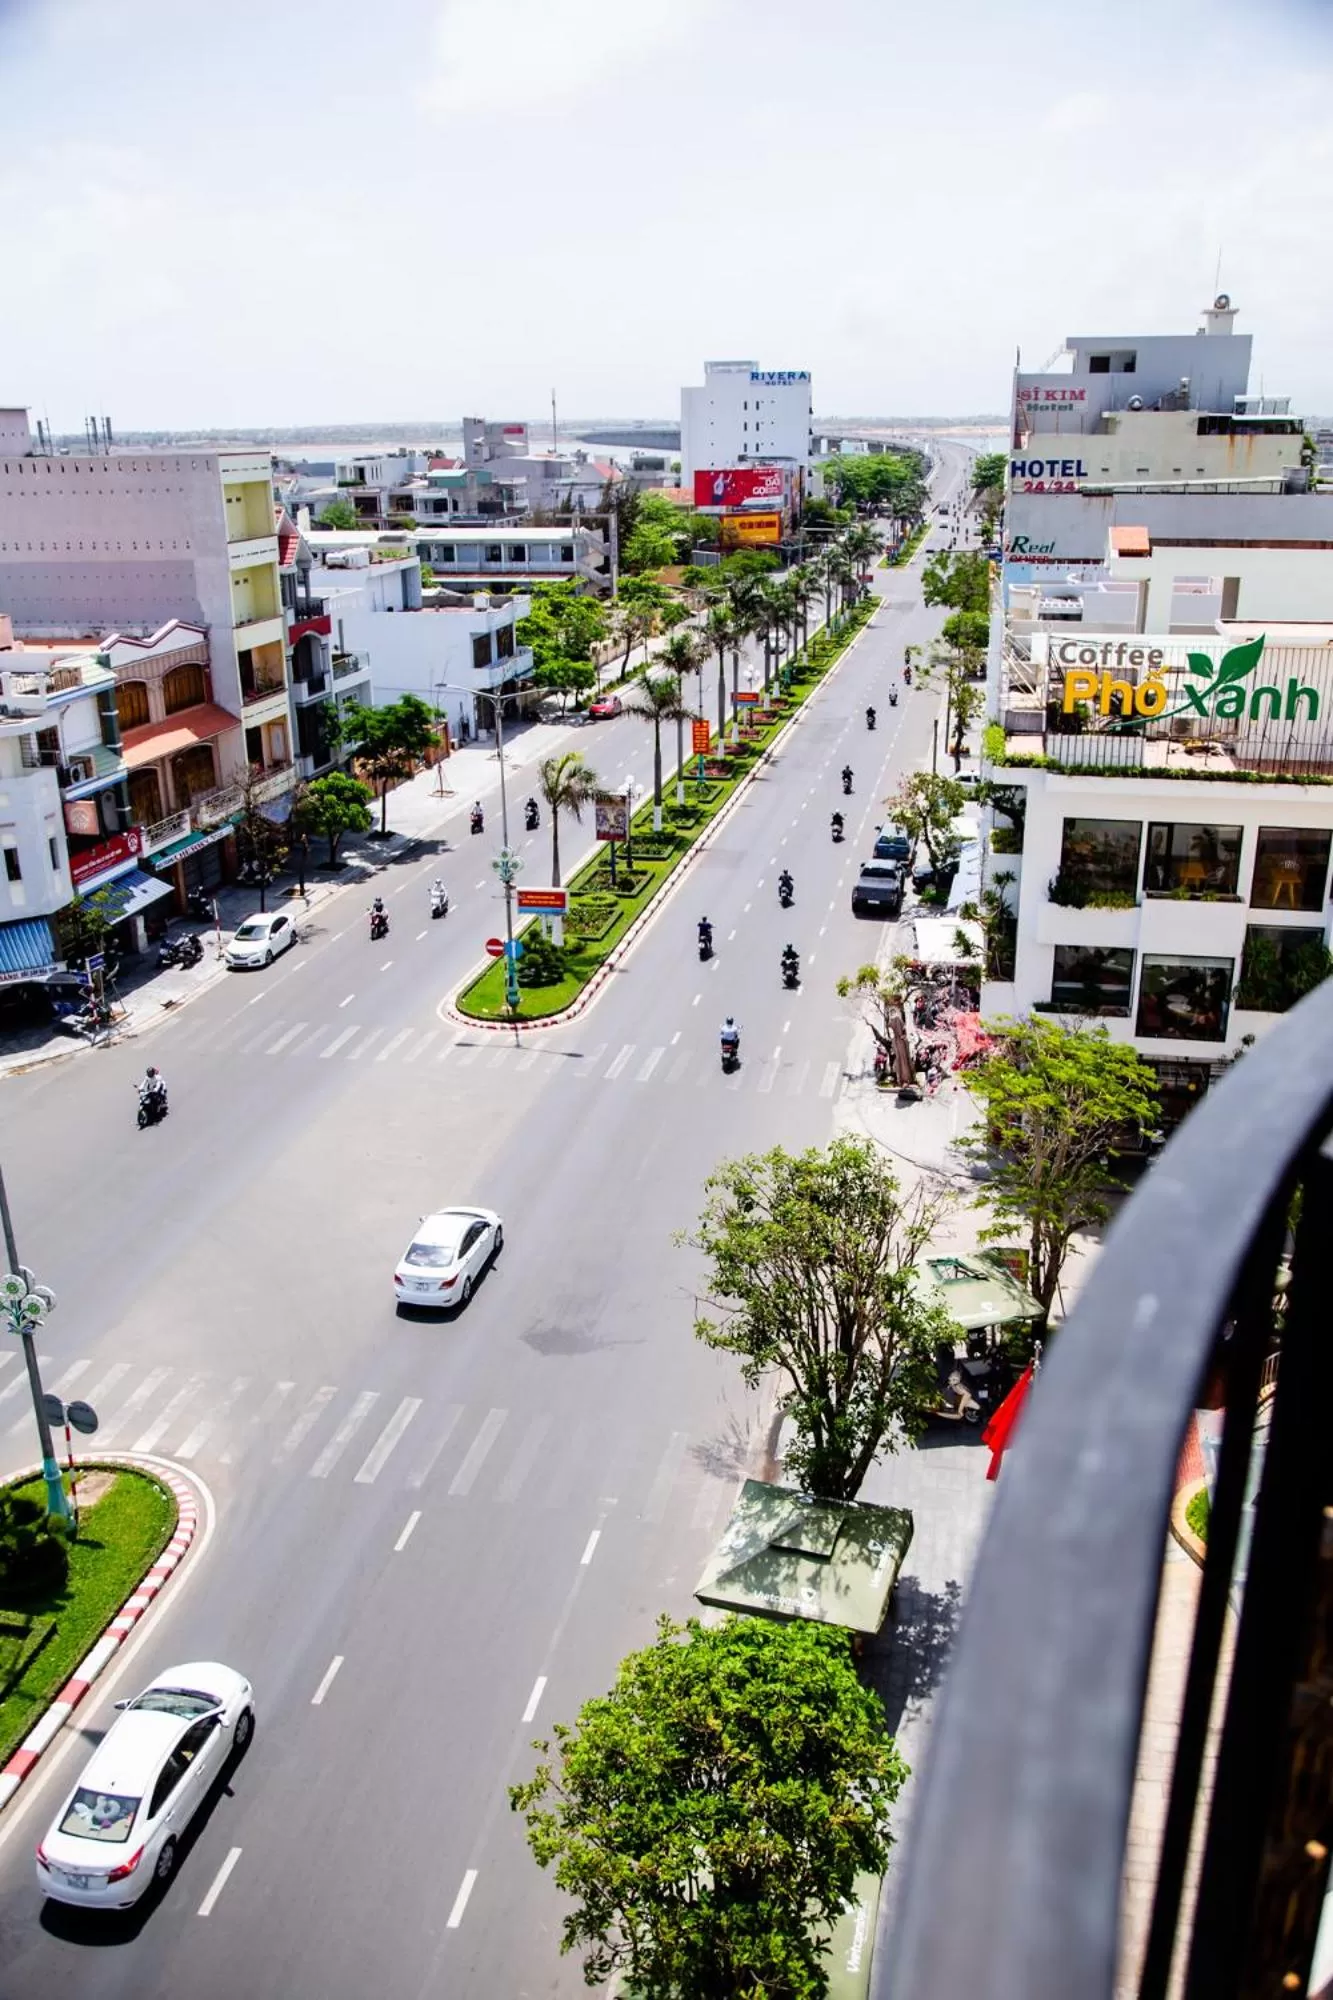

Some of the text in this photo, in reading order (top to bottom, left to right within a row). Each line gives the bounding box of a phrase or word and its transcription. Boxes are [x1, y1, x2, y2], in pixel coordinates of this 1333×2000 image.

[750, 371, 807, 381] RIVERA
[1044, 388, 1086, 401] KIM
[1026, 403, 1074, 412] Hotel
[1011, 459, 1088, 478] HOTEL
[1023, 480, 1076, 492] 24/24
[1059, 641, 1164, 666] Coffee
[1063, 665, 1171, 717] Phố
[753, 1589, 819, 1612] Vietcom
[845, 1899, 869, 1973] Vietcomb
